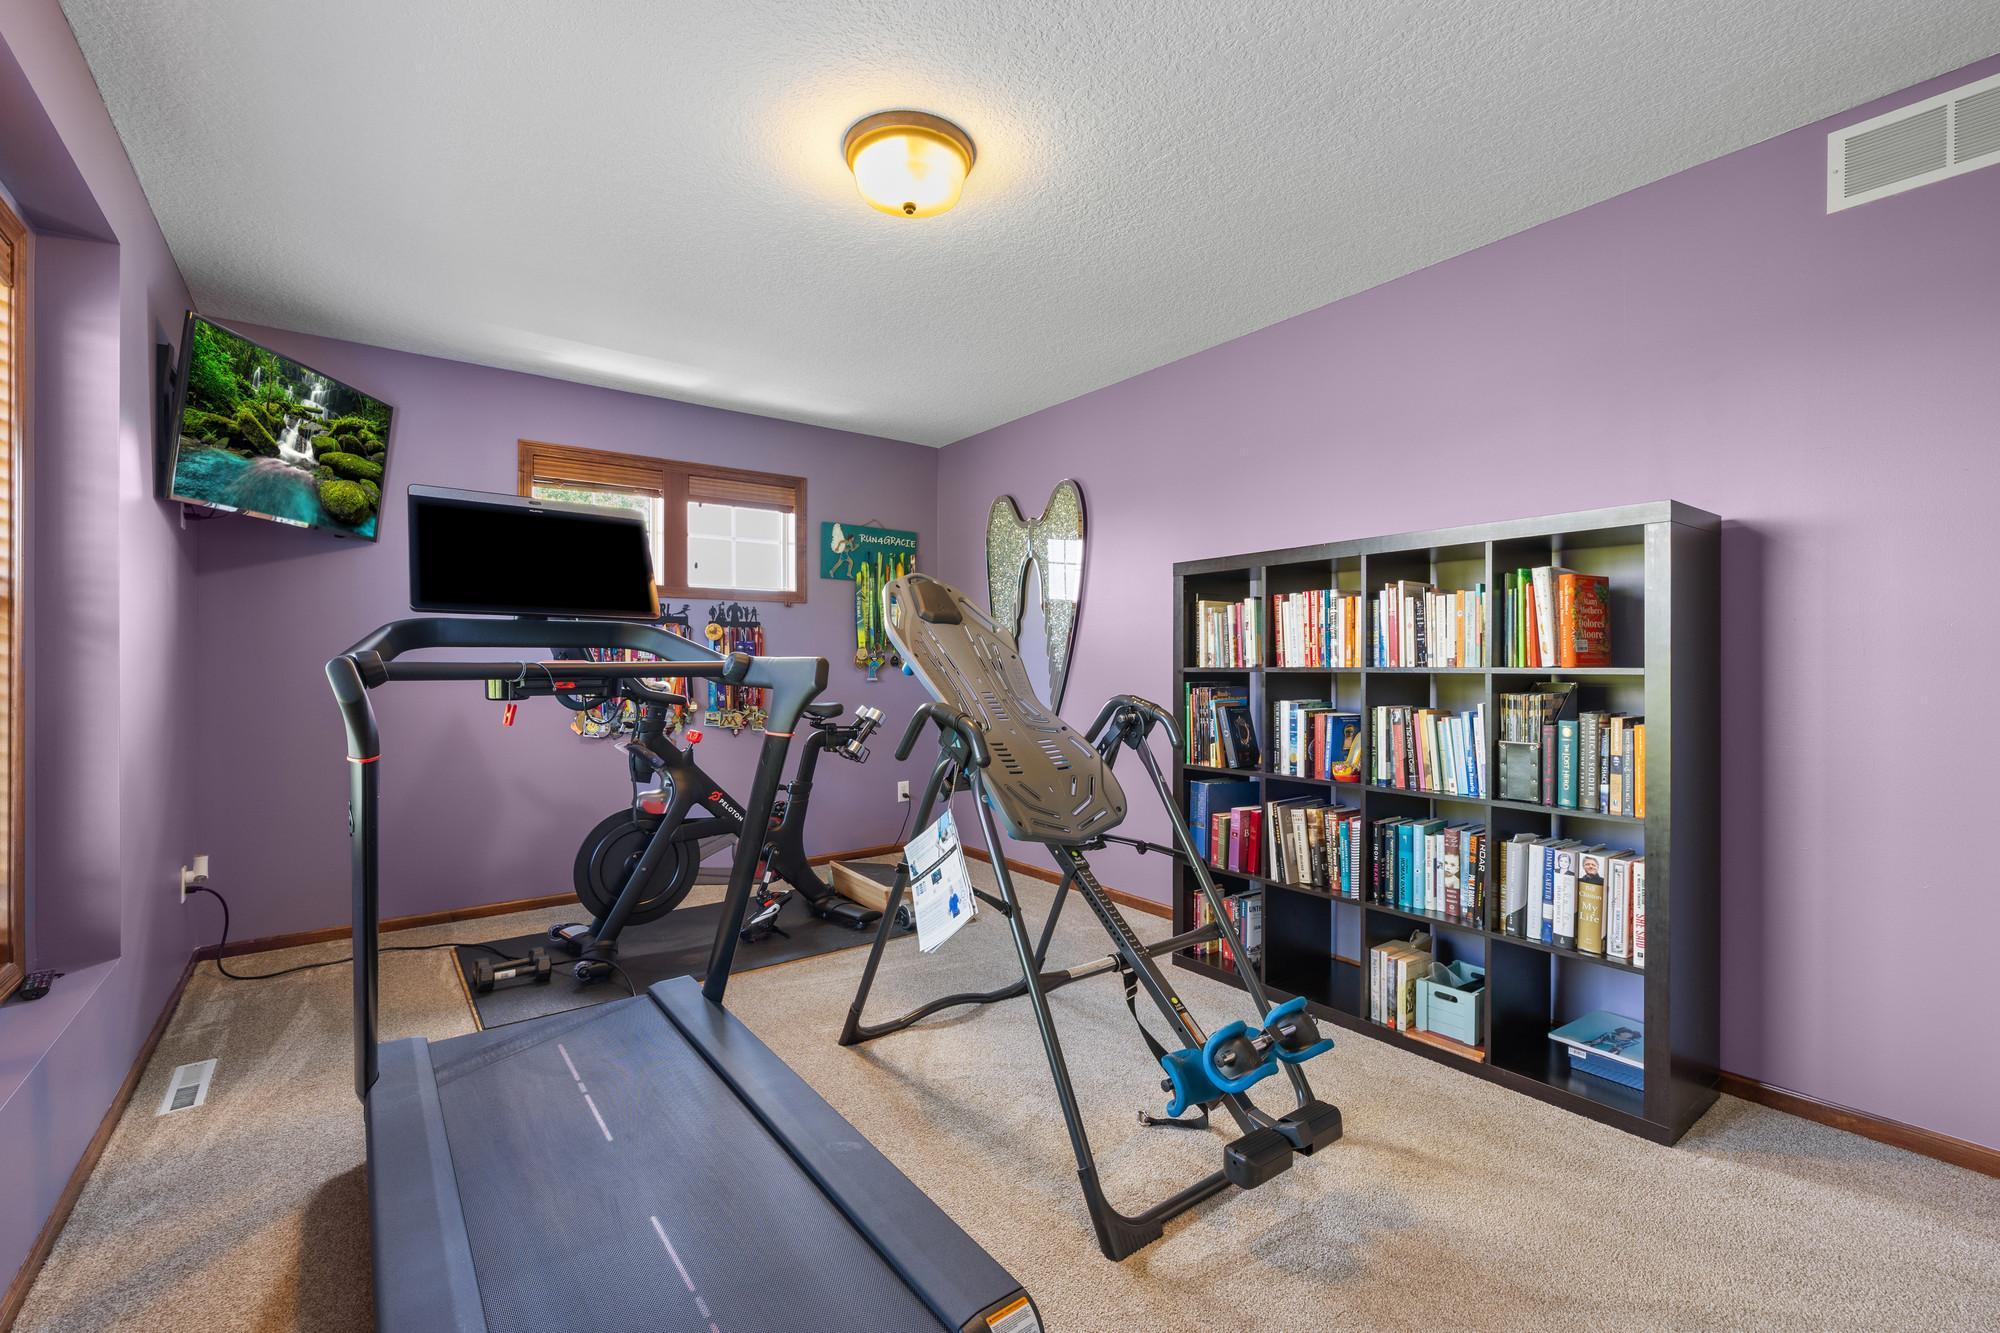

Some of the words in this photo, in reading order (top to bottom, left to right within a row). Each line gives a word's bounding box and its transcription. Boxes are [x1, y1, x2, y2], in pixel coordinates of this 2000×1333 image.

[859, 533, 917, 549] RUN4GRACIE
[659, 602, 672, 617] RL
[1588, 718, 1596, 760] AMERICAN
[1588, 762, 1596, 797] SOLDIER
[718, 798, 744, 823] PELOTON
[1478, 844, 1486, 872] ROAR
[1545, 849, 1553, 872] JIMMY
[1582, 901, 1598, 913] My
[1579, 911, 1600, 924] Life
[1635, 913, 1645, 929] SHE
[1635, 930, 1645, 949] SAID
